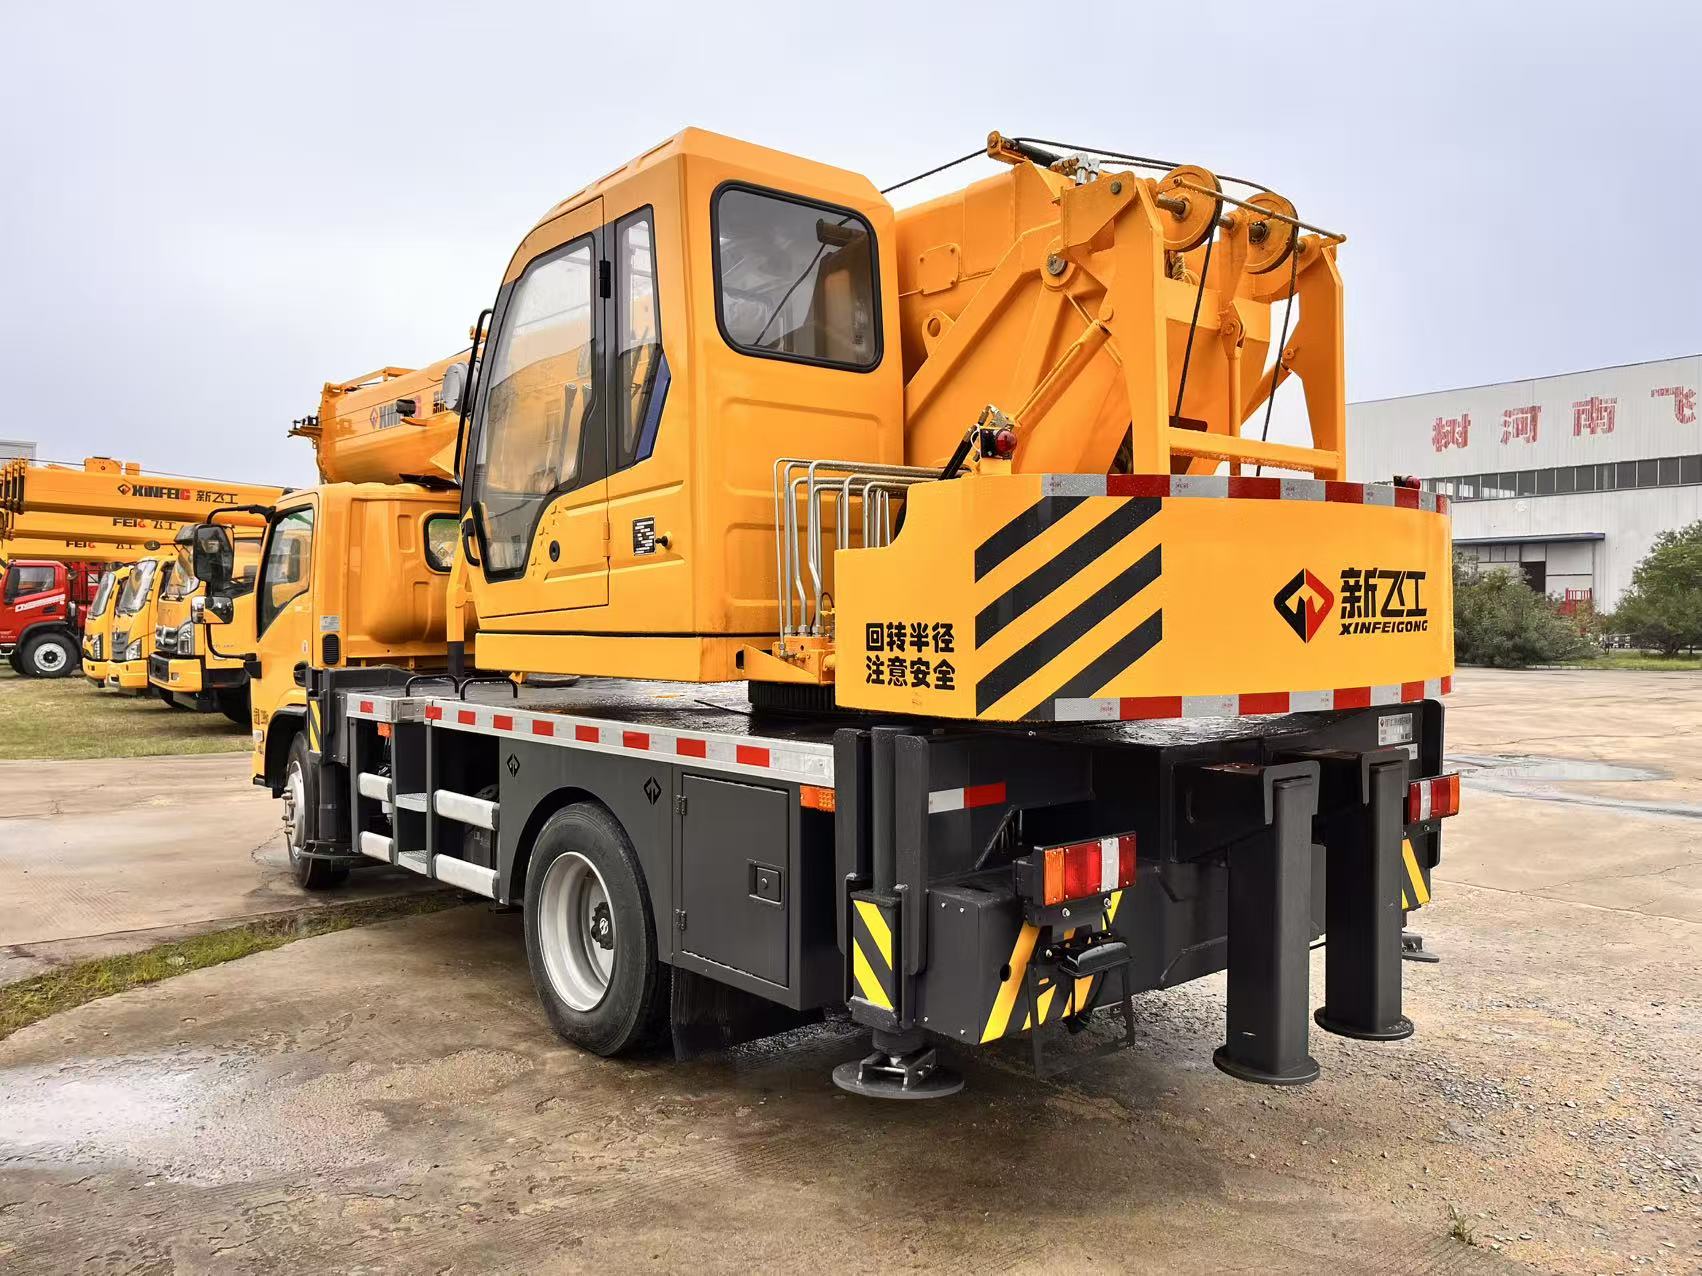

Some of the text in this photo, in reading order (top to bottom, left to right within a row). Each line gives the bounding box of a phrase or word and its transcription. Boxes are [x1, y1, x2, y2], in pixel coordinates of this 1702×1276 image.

[196, 490, 239, 505] 新飞工
[1340, 567, 1428, 619] 新飞工
[866, 621, 954, 653] 回转半径
[1338, 620, 1429, 636] XINFEIGONG
[865, 654, 955, 691] 注意安全
